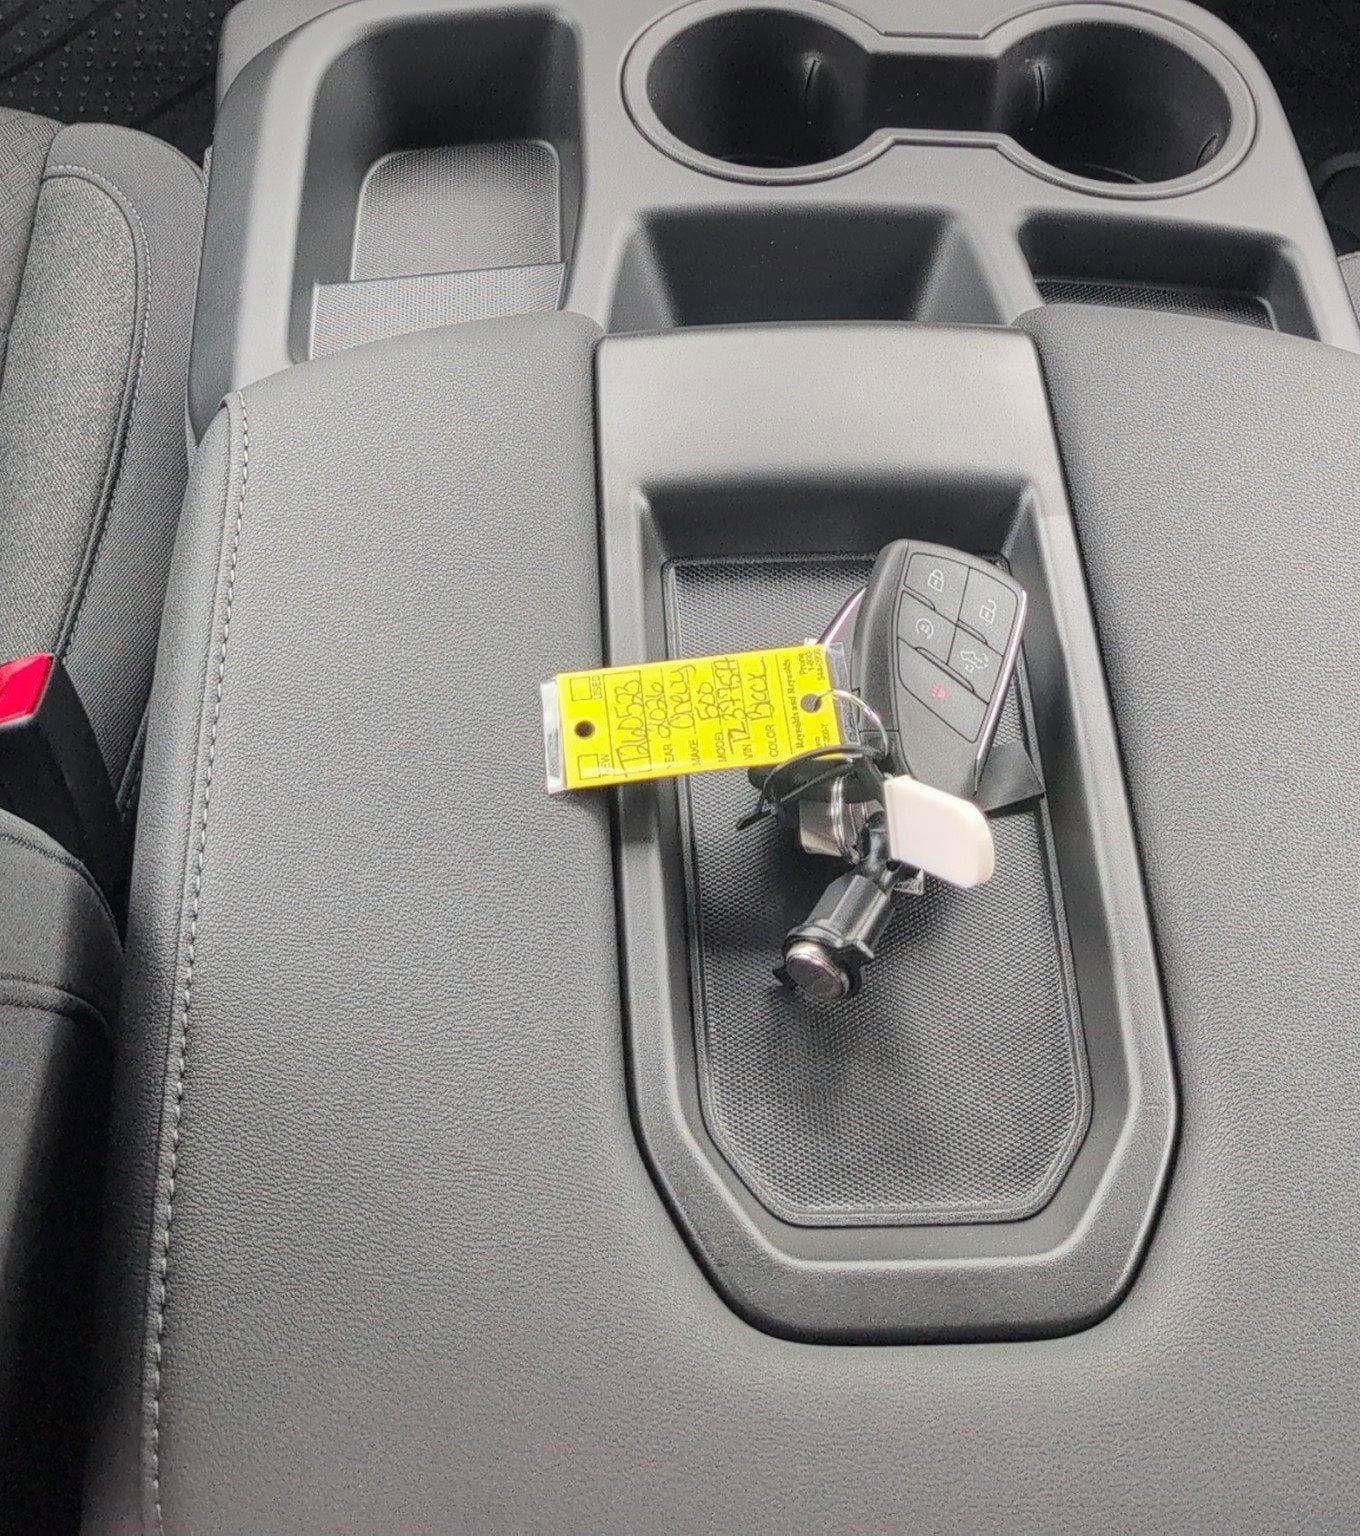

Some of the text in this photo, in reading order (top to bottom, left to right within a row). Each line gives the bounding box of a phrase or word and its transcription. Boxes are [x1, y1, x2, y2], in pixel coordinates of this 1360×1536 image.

[591, 674, 603, 700] USED
[668, 664, 697, 729] Chevy
[688, 739, 701, 766] MAKE
[714, 729, 727, 763] MODEL
[742, 744, 753, 760] VIN
[765, 724, 779, 758] COLOR
